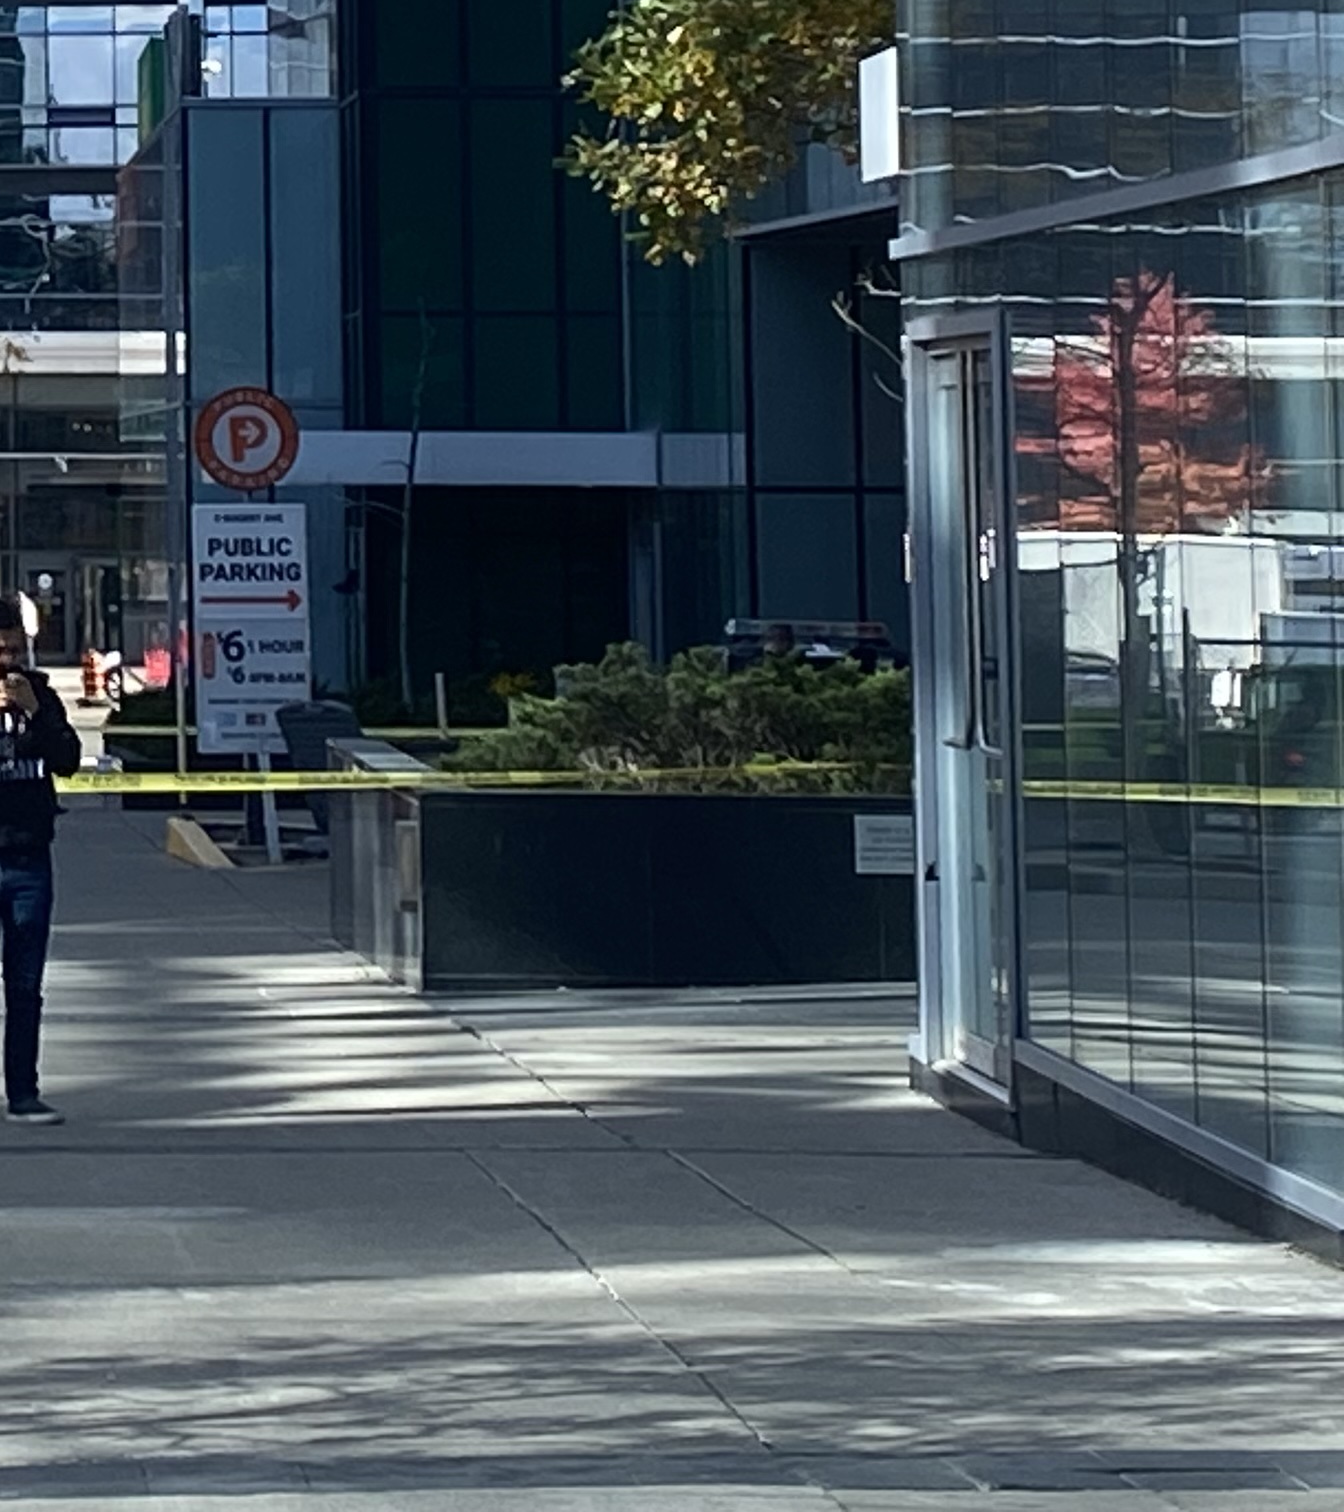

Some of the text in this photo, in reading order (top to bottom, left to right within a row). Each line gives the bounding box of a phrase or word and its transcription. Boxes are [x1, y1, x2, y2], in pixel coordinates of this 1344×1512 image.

[207, 536, 292, 557] PUBLIC
[199, 562, 302, 582] PARKING
[258, 639, 305, 654] HOUR
